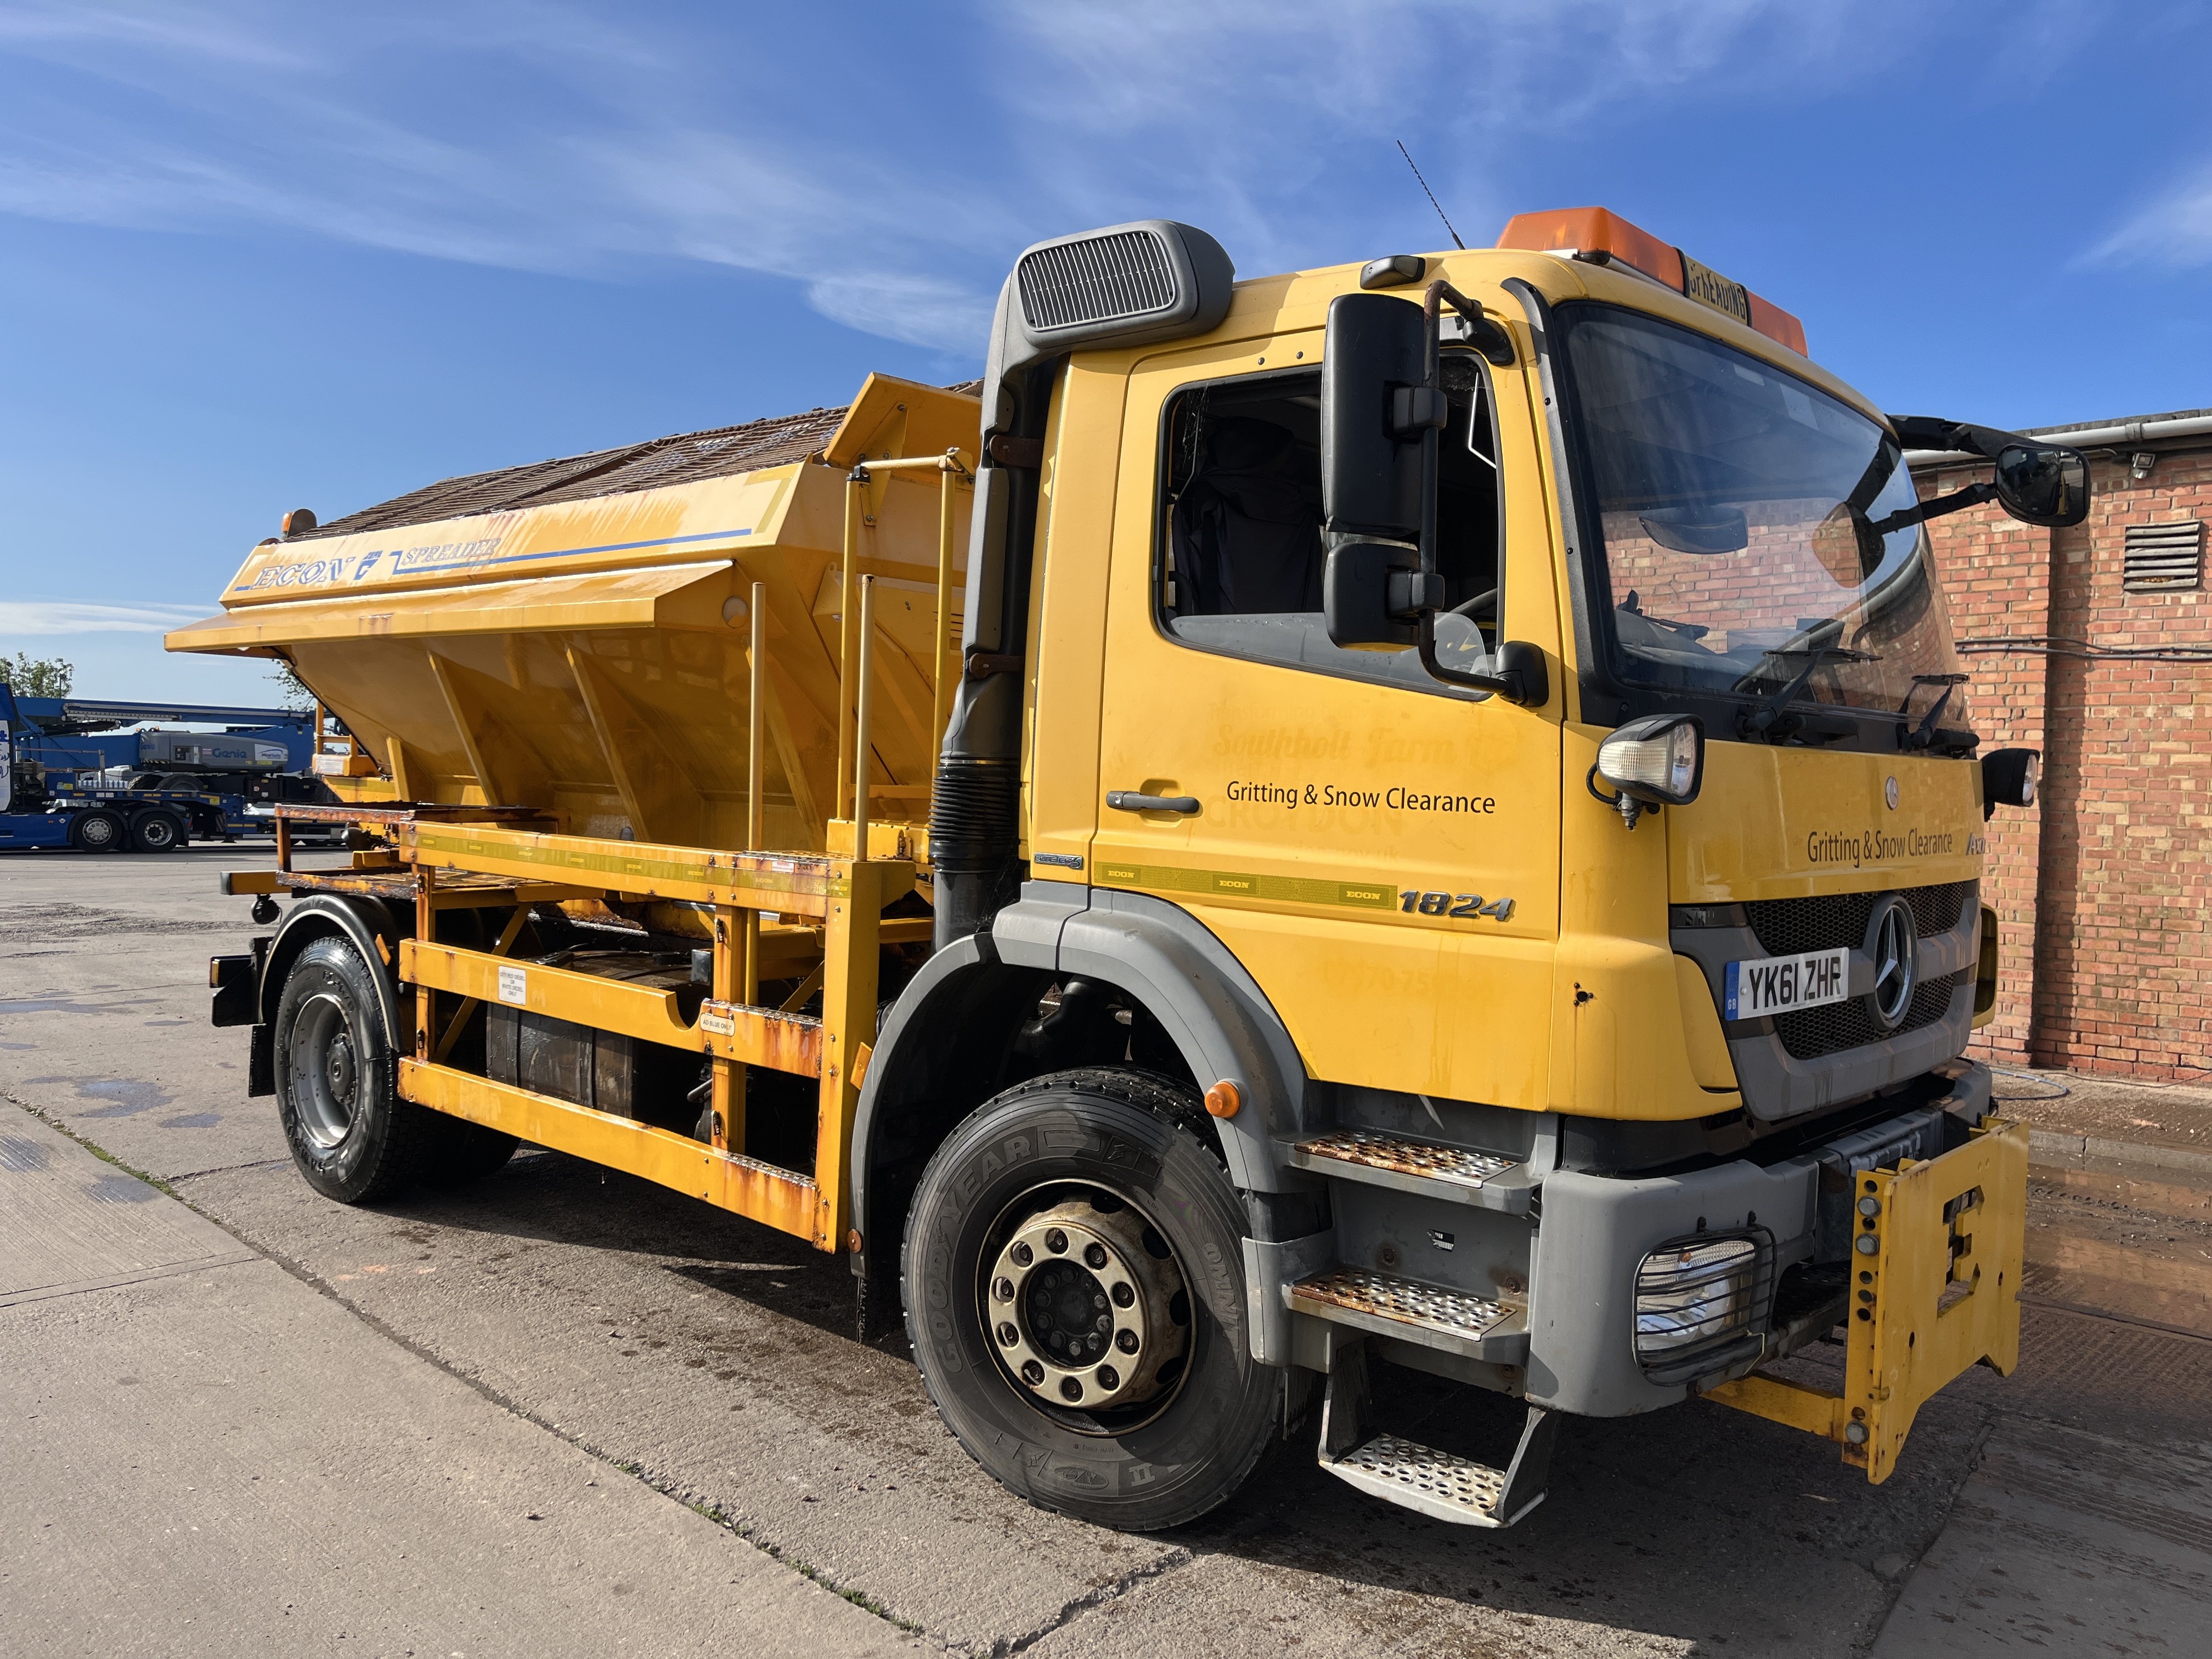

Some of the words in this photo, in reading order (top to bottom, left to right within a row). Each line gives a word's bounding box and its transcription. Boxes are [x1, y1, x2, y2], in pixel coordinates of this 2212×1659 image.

[251, 556, 355, 590] ECON
[402, 538, 502, 566] SPREADER
[212, 748, 247, 759] Genie
[1227, 781, 1298, 809] Gritting
[1304, 784, 1318, 805] &
[1323, 785, 1380, 808] Snow
[1386, 787, 1496, 814] Clearance
[1807, 830, 1860, 869] Gritting
[1864, 830, 1873, 860] &
[1875, 830, 1906, 860] Snow
[1908, 827, 1953, 857] Clearance
[1966, 832, 1986, 856] Axo
[1107, 870, 1135, 879] ECON
[1219, 879, 1250, 889] ECON
[1346, 890, 1381, 900] ECON
[1399, 889, 1514, 922] 1824
[1748, 962, 1799, 1010] YK61
[1804, 956, 1842, 1001] ZHR
[1728, 997, 1737, 1011] GB
[927, 1135, 1032, 1373] GOODYEAR
[1128, 1462, 1156, 1487] II
